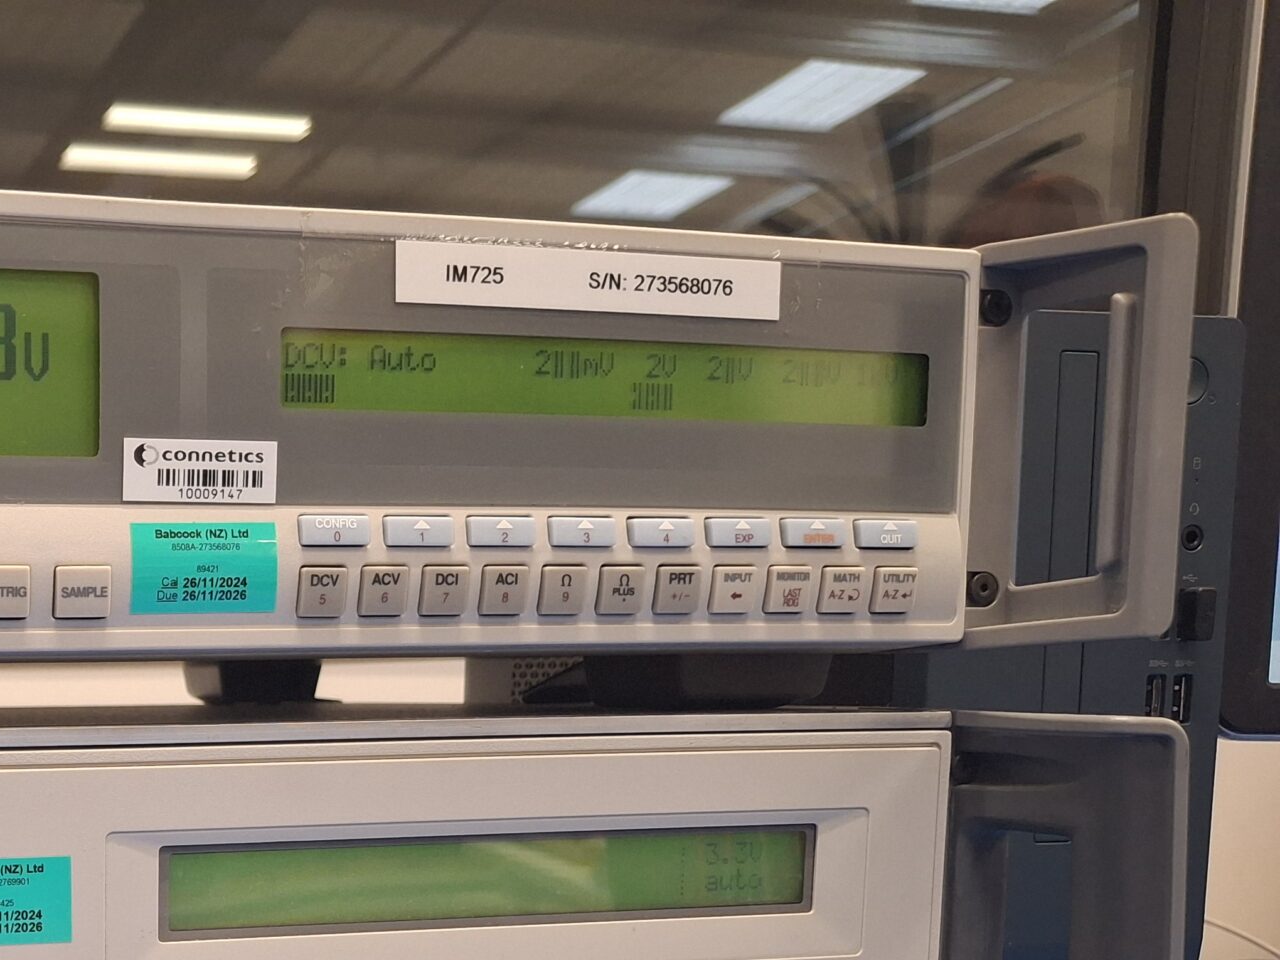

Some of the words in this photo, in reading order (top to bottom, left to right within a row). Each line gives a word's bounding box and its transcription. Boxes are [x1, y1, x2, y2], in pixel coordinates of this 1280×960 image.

[446, 264, 505, 285] IM725
[588, 272, 628, 292] S/N:
[634, 275, 734, 297] 273568076
[284, 342, 348, 369] DCV:
[370, 345, 437, 372] Auto
[646, 354, 677, 379] 2V
[162, 448, 264, 464] connetics
[178, 487, 243, 500] 10009147
[315, 518, 357, 529] CONFIG
[155, 529, 202, 539] Babcock
[205, 529, 228, 541] (NZ)
[231, 529, 249, 539] Ltd
[735, 533, 755, 544] EXP
[881, 533, 902, 545] QUIT
[161, 577, 178, 588] Cal
[183, 577, 247, 588] 26/11/2024
[310, 574, 339, 588] DCV
[371, 572, 401, 586] ACV
[435, 573, 459, 586] DCI
[495, 572, 518, 586] ACI
[669, 572, 694, 586] PRT
[723, 572, 753, 583] INPUT
[833, 572, 860, 583] MATH
[0, 586, 27, 598] TRIG
[61, 586, 108, 598] SAMPLE
[157, 590, 177, 602] Due
[182, 590, 247, 601] 26/11/2026
[612, 587, 635, 597] PLUS
[0, 864, 23, 877] (NZ)
[26, 863, 44, 875] Ltd
